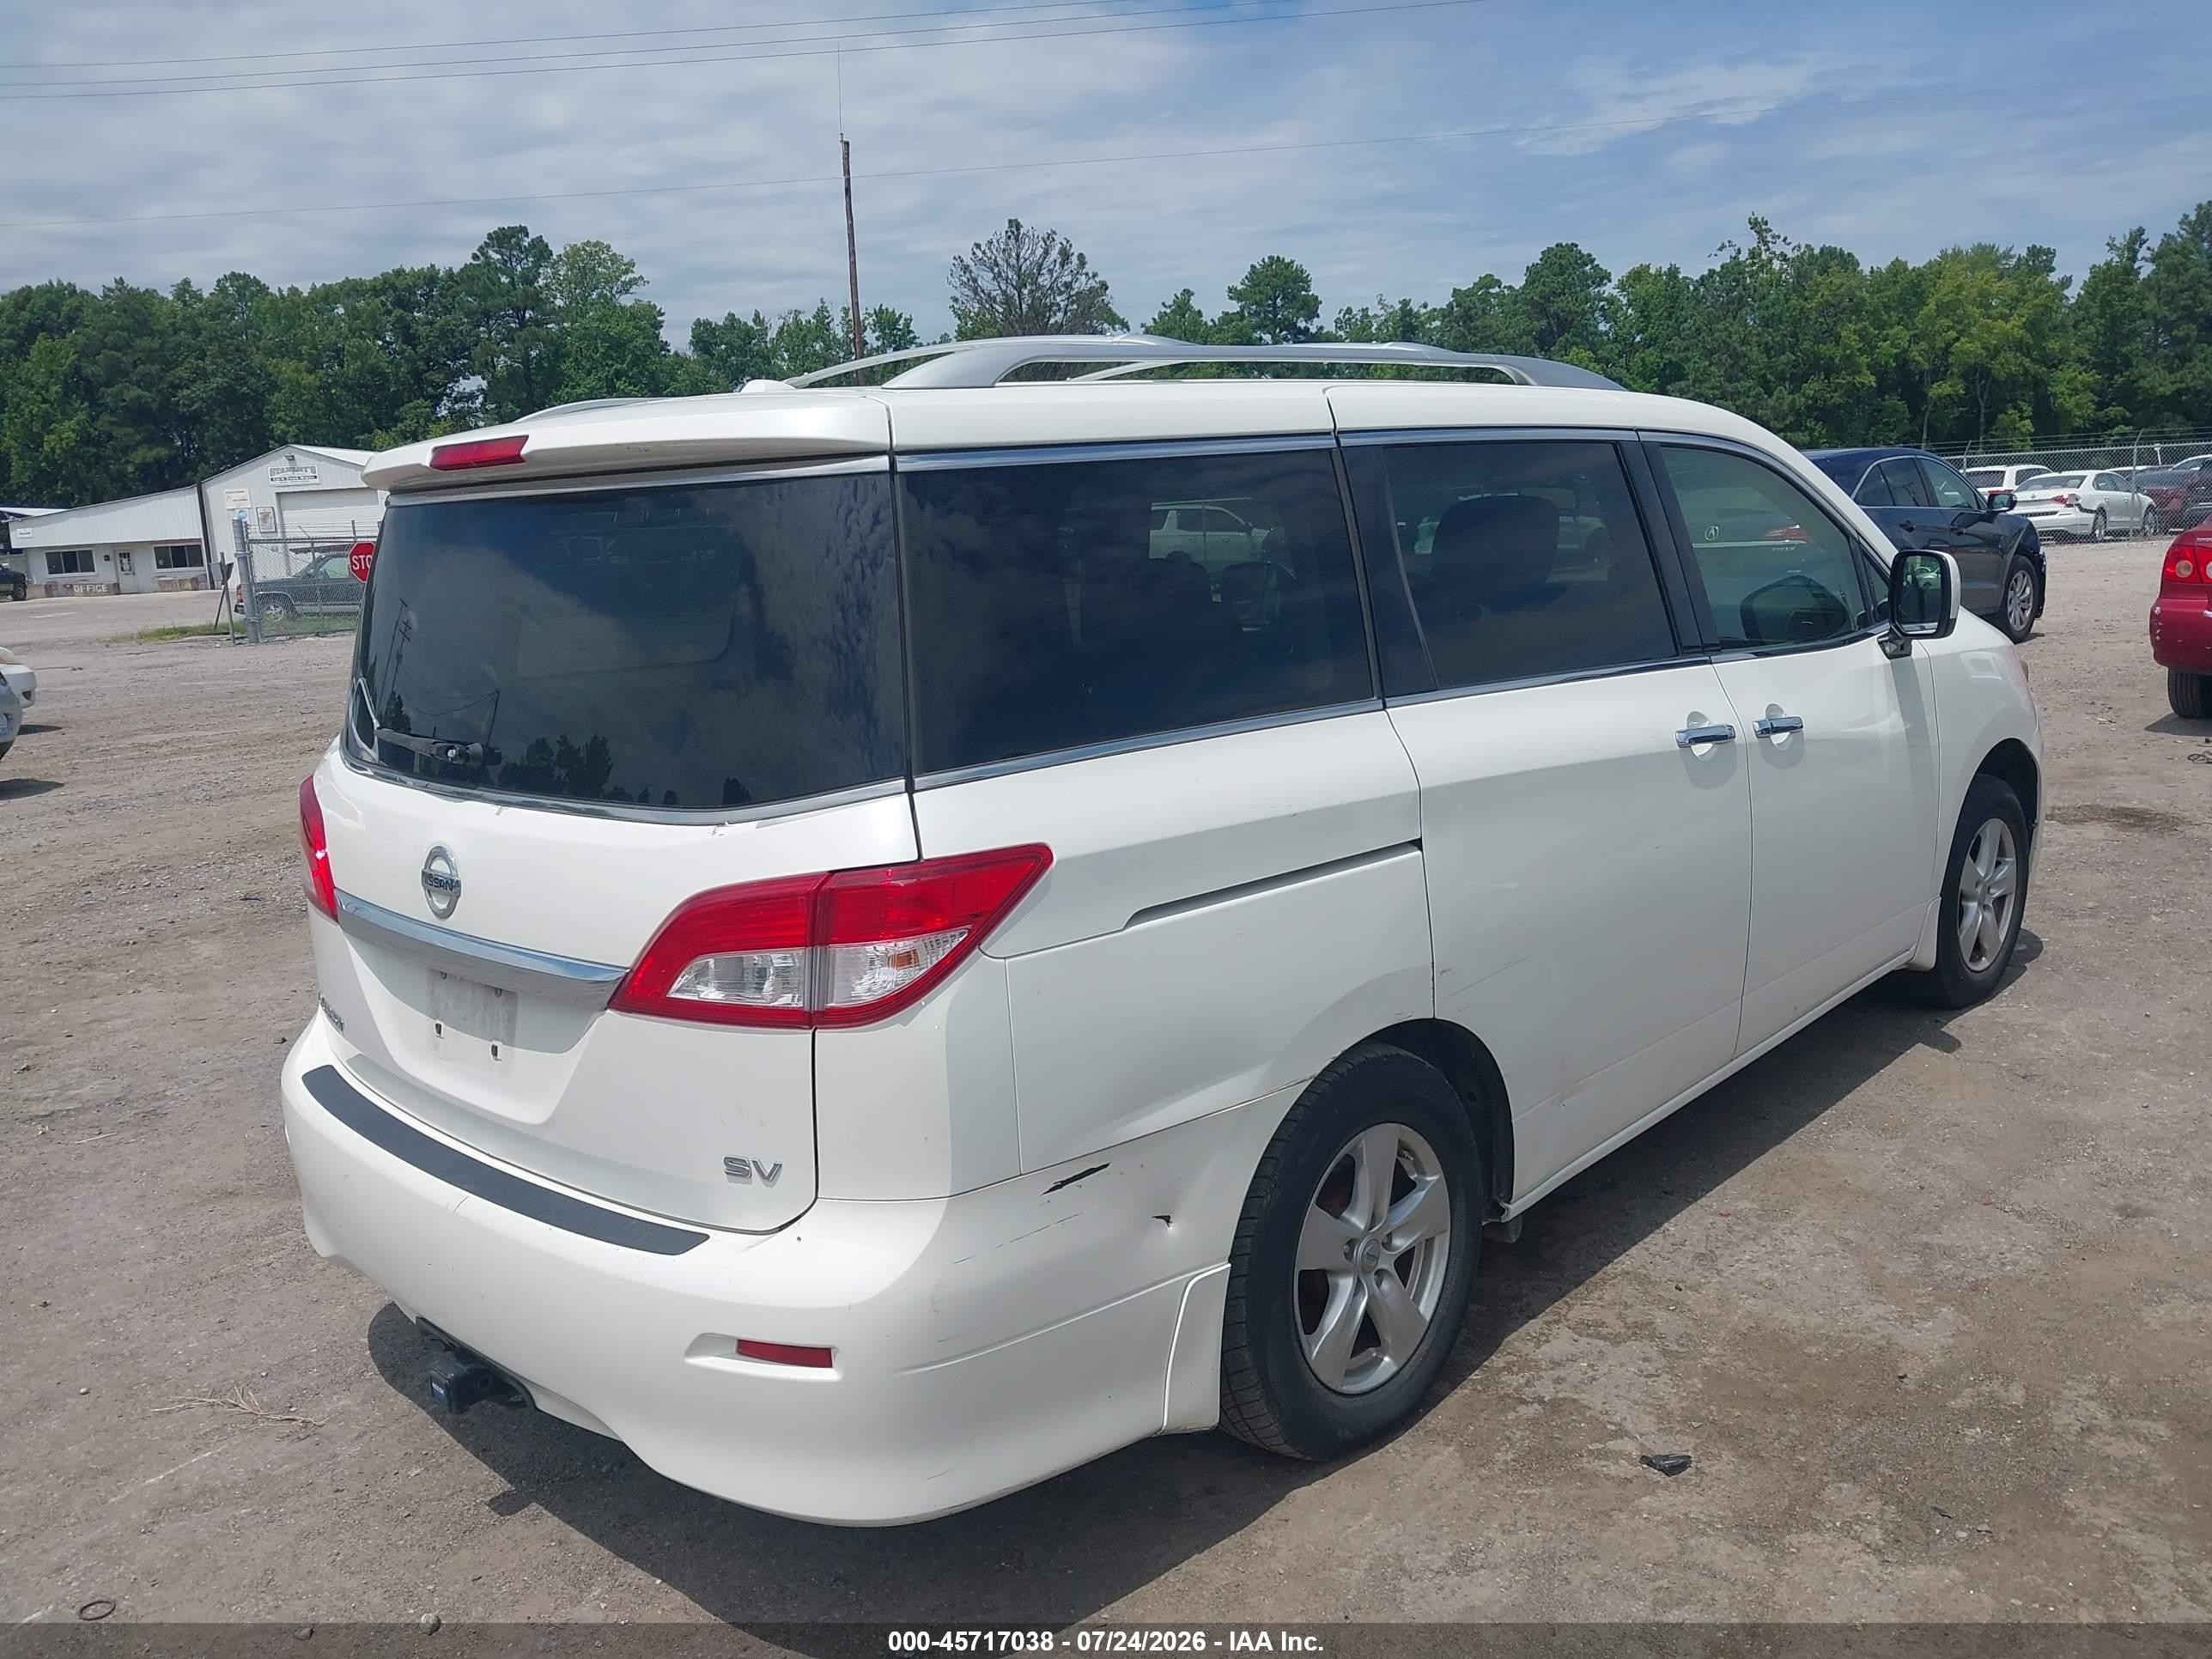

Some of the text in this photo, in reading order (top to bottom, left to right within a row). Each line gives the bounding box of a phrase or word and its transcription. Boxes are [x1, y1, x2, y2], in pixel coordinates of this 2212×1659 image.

[352, 555, 373, 570] STO
[73, 584, 108, 592] OFFICE
[422, 871, 453, 891] NISSAN
[723, 1155, 783, 1184] SV
